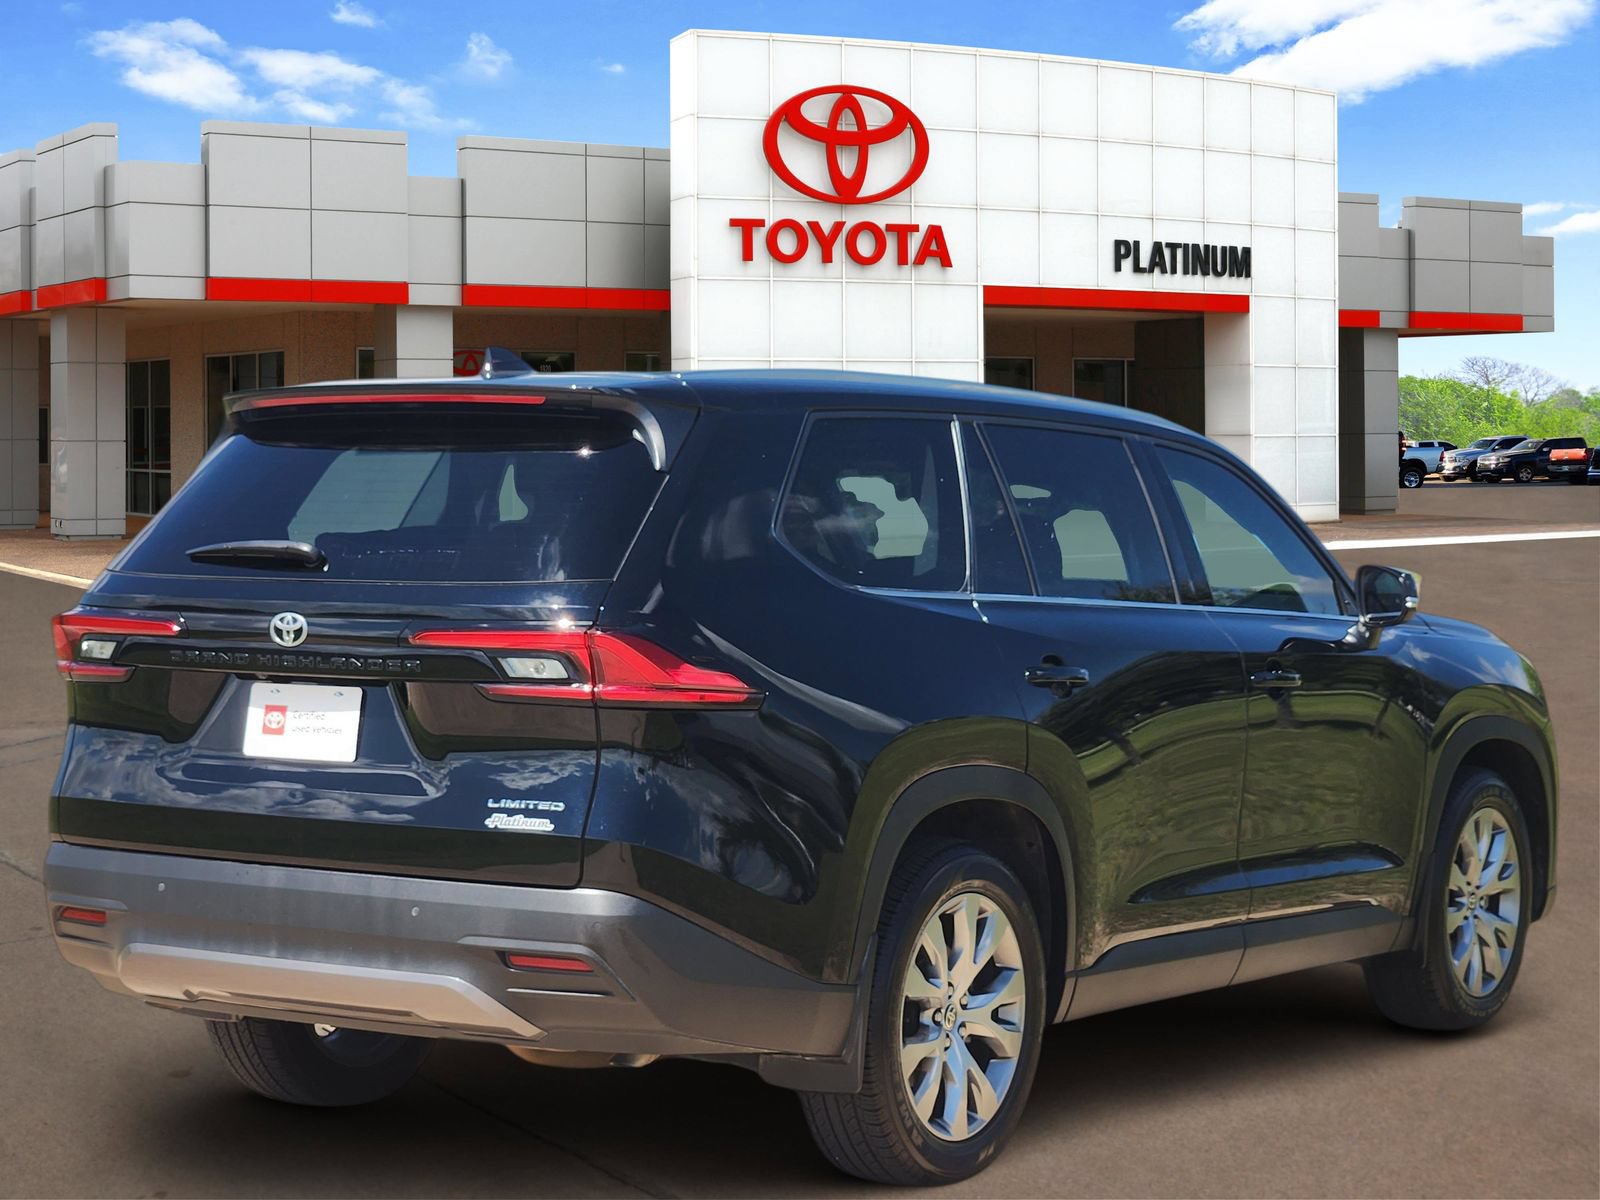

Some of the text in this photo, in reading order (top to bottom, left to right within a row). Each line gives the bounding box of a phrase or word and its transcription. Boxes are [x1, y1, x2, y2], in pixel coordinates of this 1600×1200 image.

[729, 217, 953, 269] TOYOTA
[1114, 239, 1252, 278] PLATINUM
[169, 649, 422, 673] GRAND HIGHLANDER
[487, 798, 566, 811] LIMITED
[485, 813, 555, 831] Platinum
